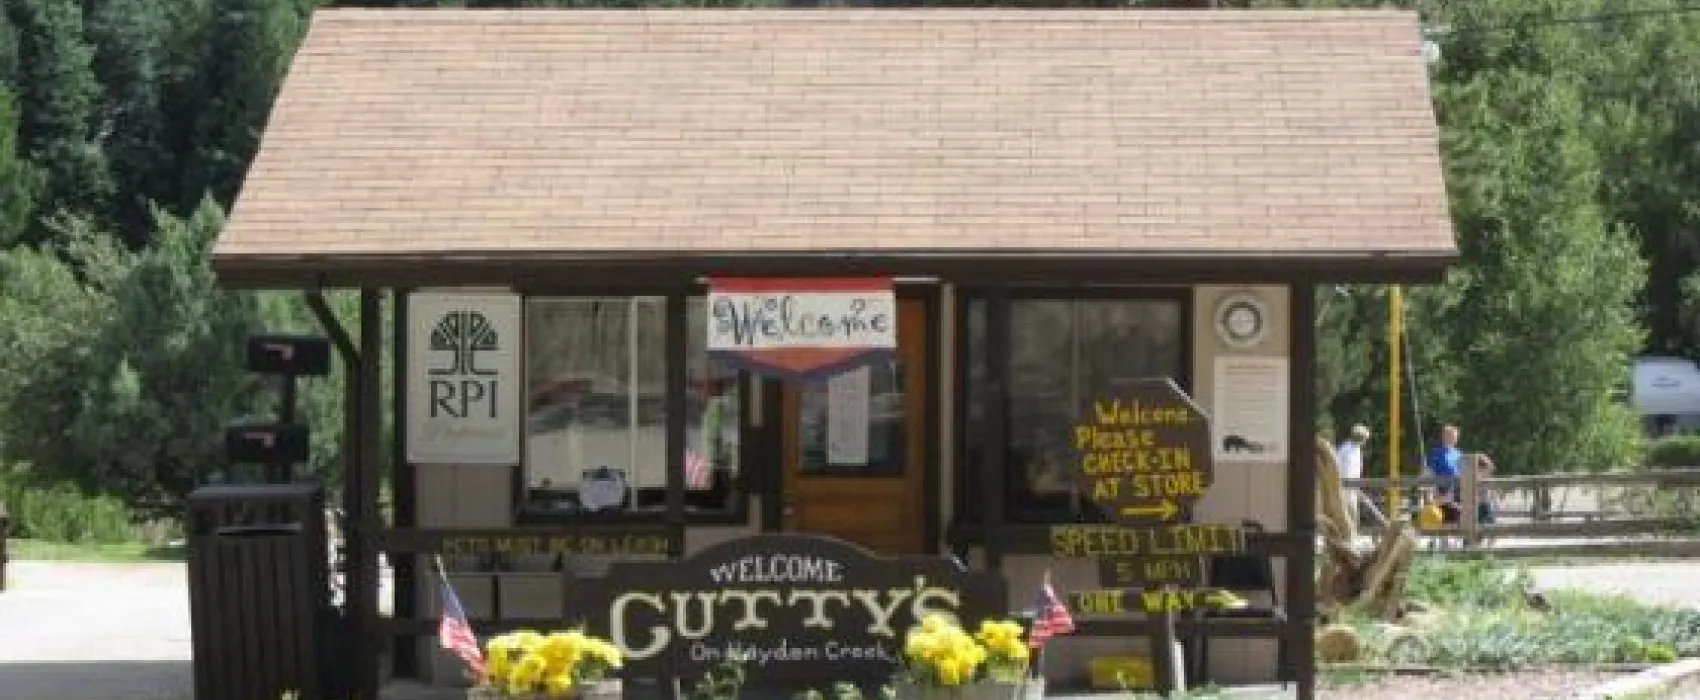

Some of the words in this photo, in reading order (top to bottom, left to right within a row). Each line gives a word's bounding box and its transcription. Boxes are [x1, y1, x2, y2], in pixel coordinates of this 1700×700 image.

[712, 295, 887, 345] Welcome
[429, 380, 498, 418] RPI
[1094, 397, 1189, 425] Welcome
[1074, 425, 1154, 450] Please
[1083, 446, 1191, 474] CHECK-IN
[1093, 477, 1118, 500] AT
[1131, 471, 1206, 497] STORE
[1051, 526, 1140, 556] SPEED
[1150, 525, 1246, 556] LIMIT
[710, 554, 844, 583] WELCOME
[1116, 562, 1133, 581] 5
[1143, 561, 1191, 581] MPH
[1079, 590, 1124, 612] ONE
[1142, 590, 1194, 612] WAY
[692, 641, 720, 661] On
[726, 638, 818, 666] Hayden
[825, 641, 893, 661] Creek
